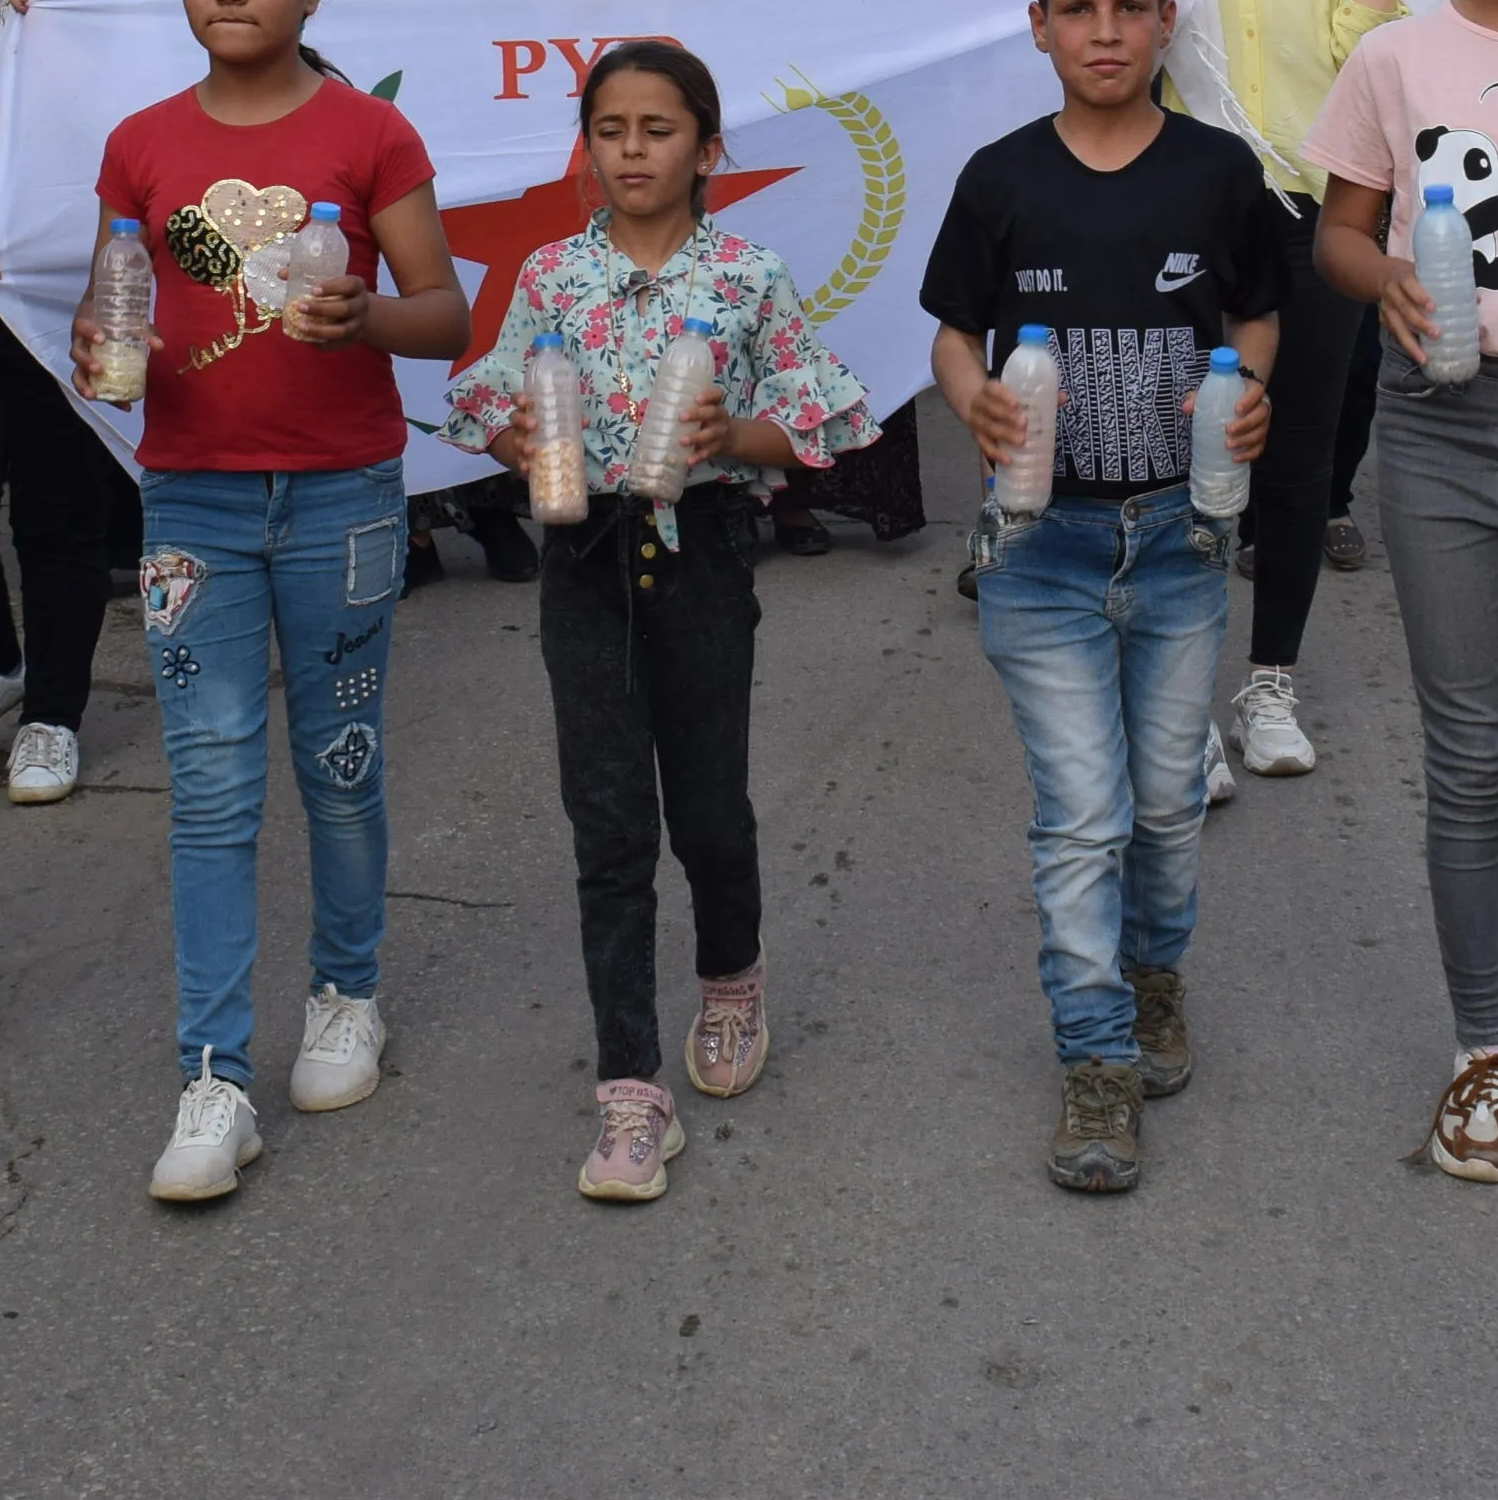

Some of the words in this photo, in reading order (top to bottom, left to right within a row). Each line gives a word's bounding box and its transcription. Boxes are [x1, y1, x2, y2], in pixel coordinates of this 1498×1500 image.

[492, 35, 686, 101] PY
[1162, 252, 1200, 275] NIKE
[1015, 270, 1035, 293] JUST
[1036, 268, 1051, 293] DO
